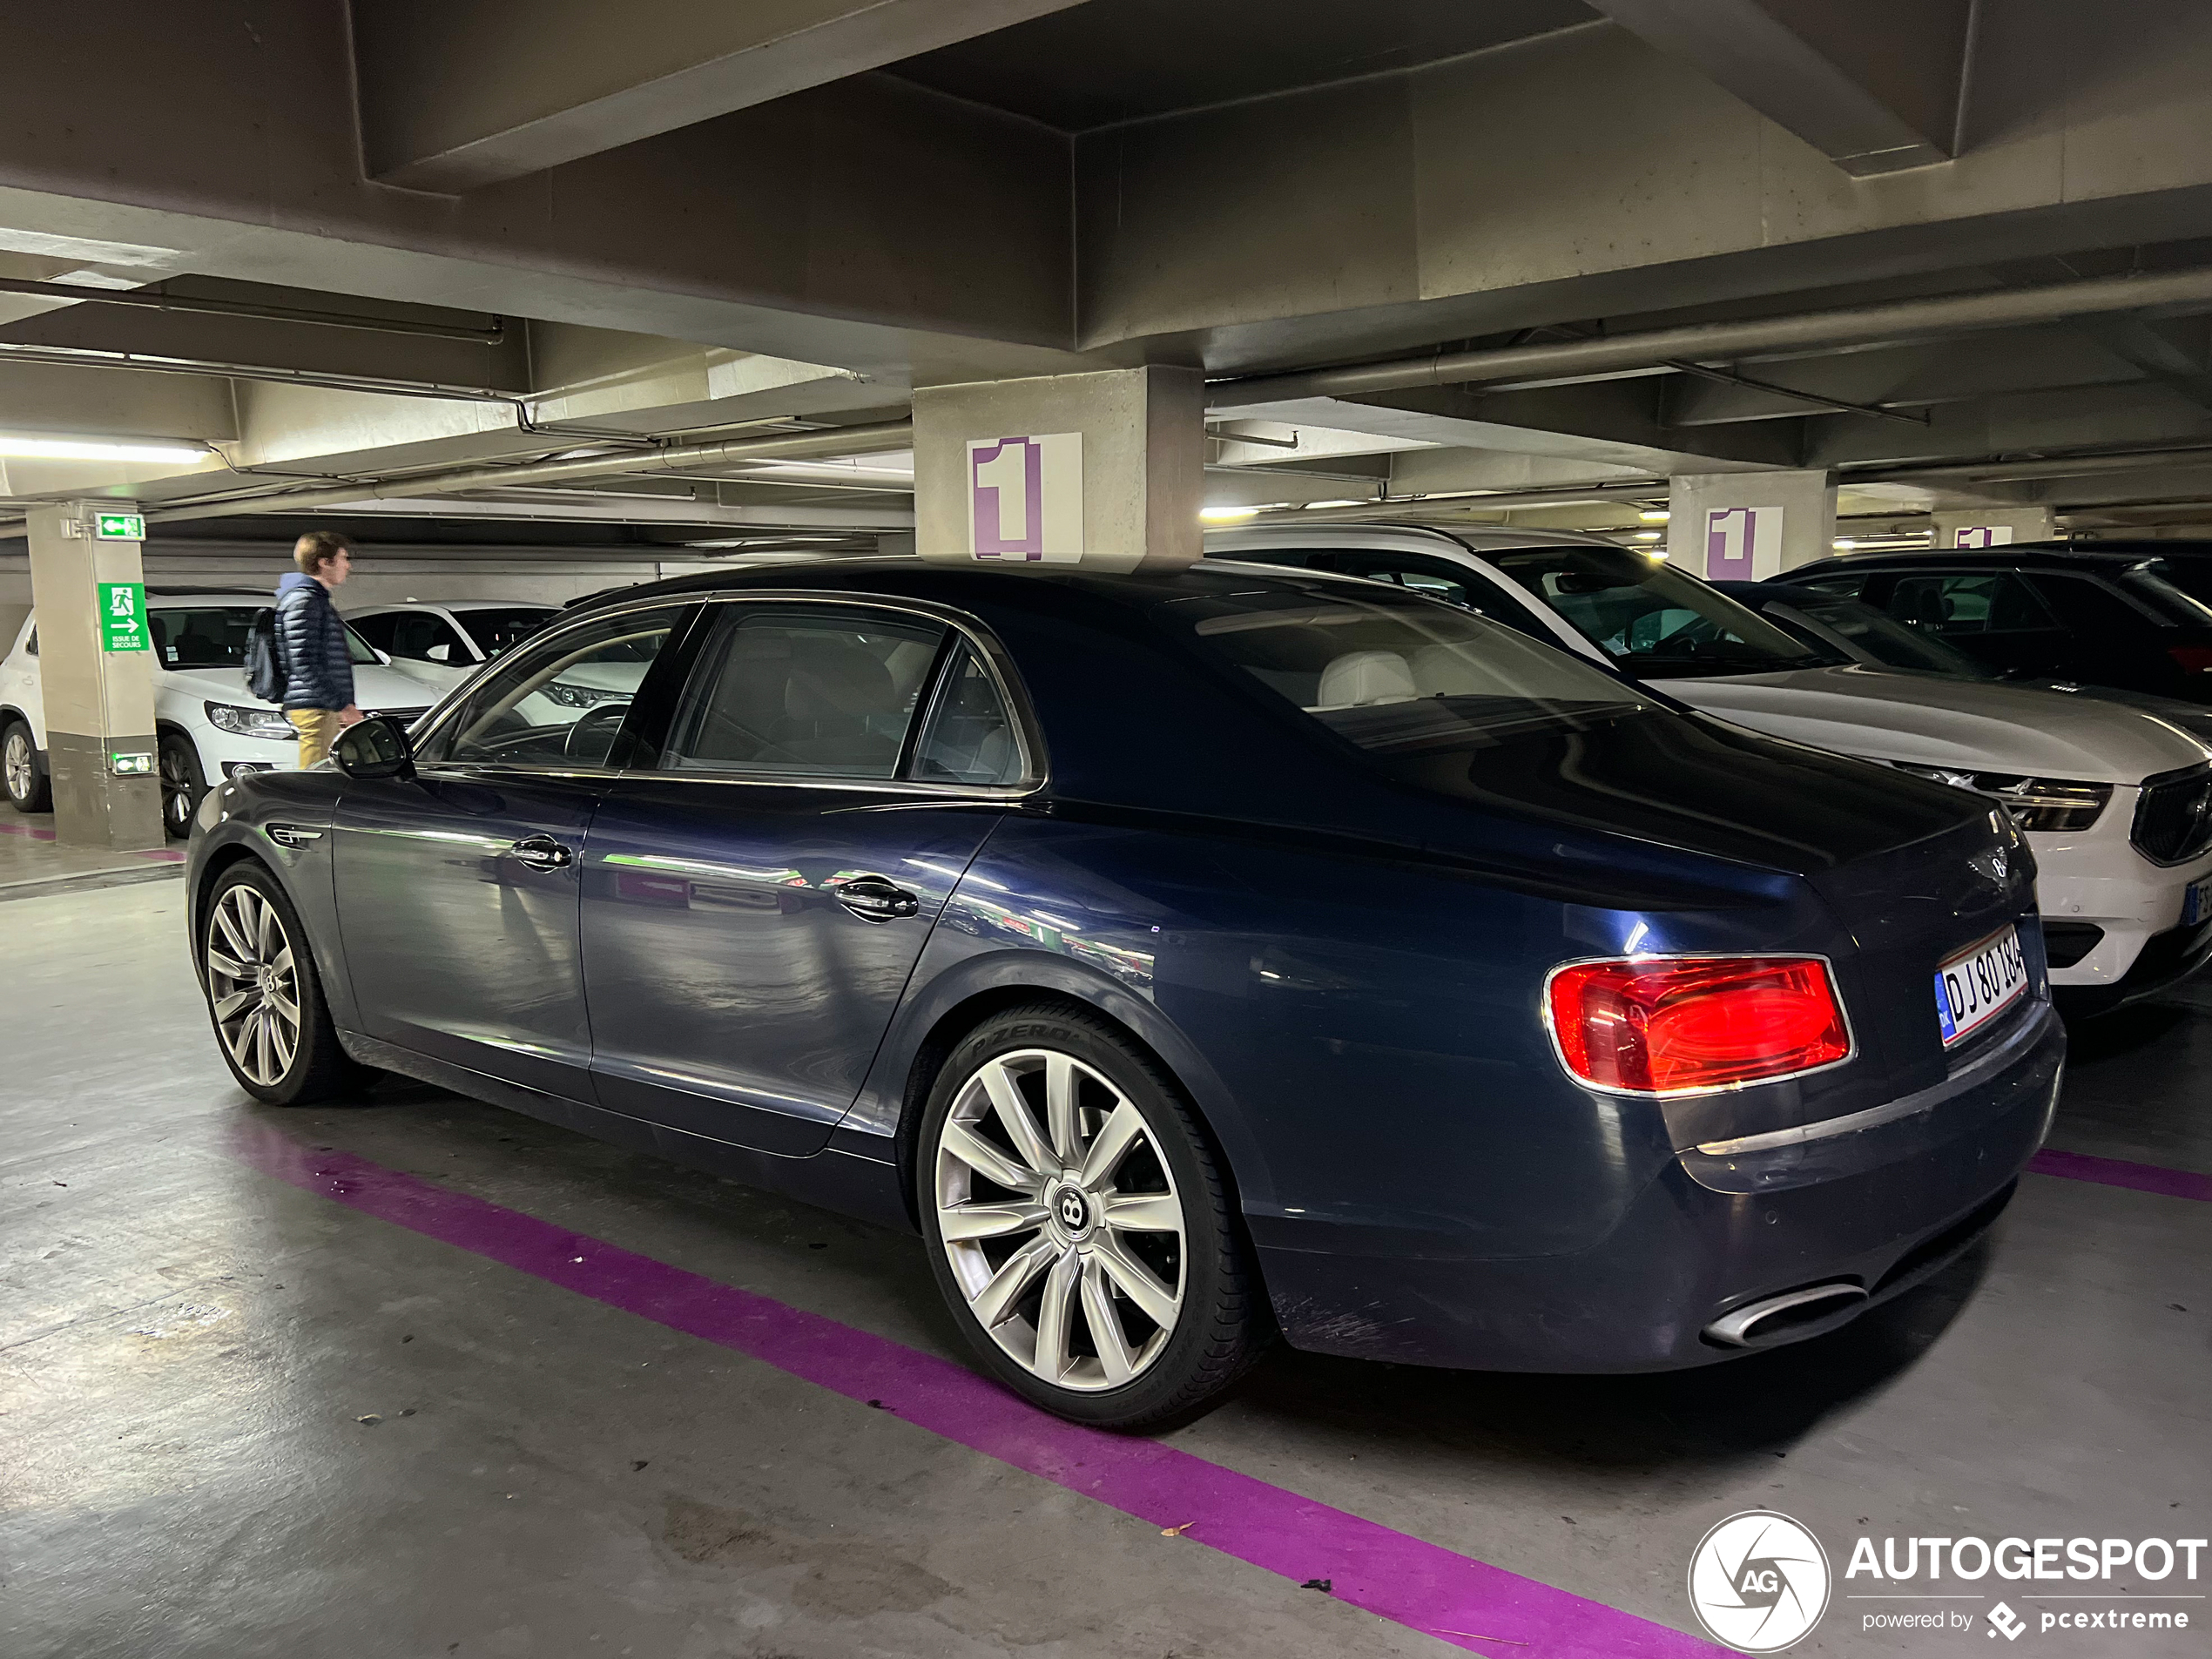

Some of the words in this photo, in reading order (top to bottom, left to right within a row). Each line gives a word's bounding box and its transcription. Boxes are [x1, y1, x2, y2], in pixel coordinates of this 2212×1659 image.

[974, 440, 1029, 543] 1
[1711, 509, 1747, 560] 1
[1946, 964, 1977, 1022] DJ
[1976, 950, 2000, 1004] 80
[1997, 931, 2024, 988] 184
[993, 1024, 1071, 1044] ZERO
[1939, 1010, 1951, 1028] DK
